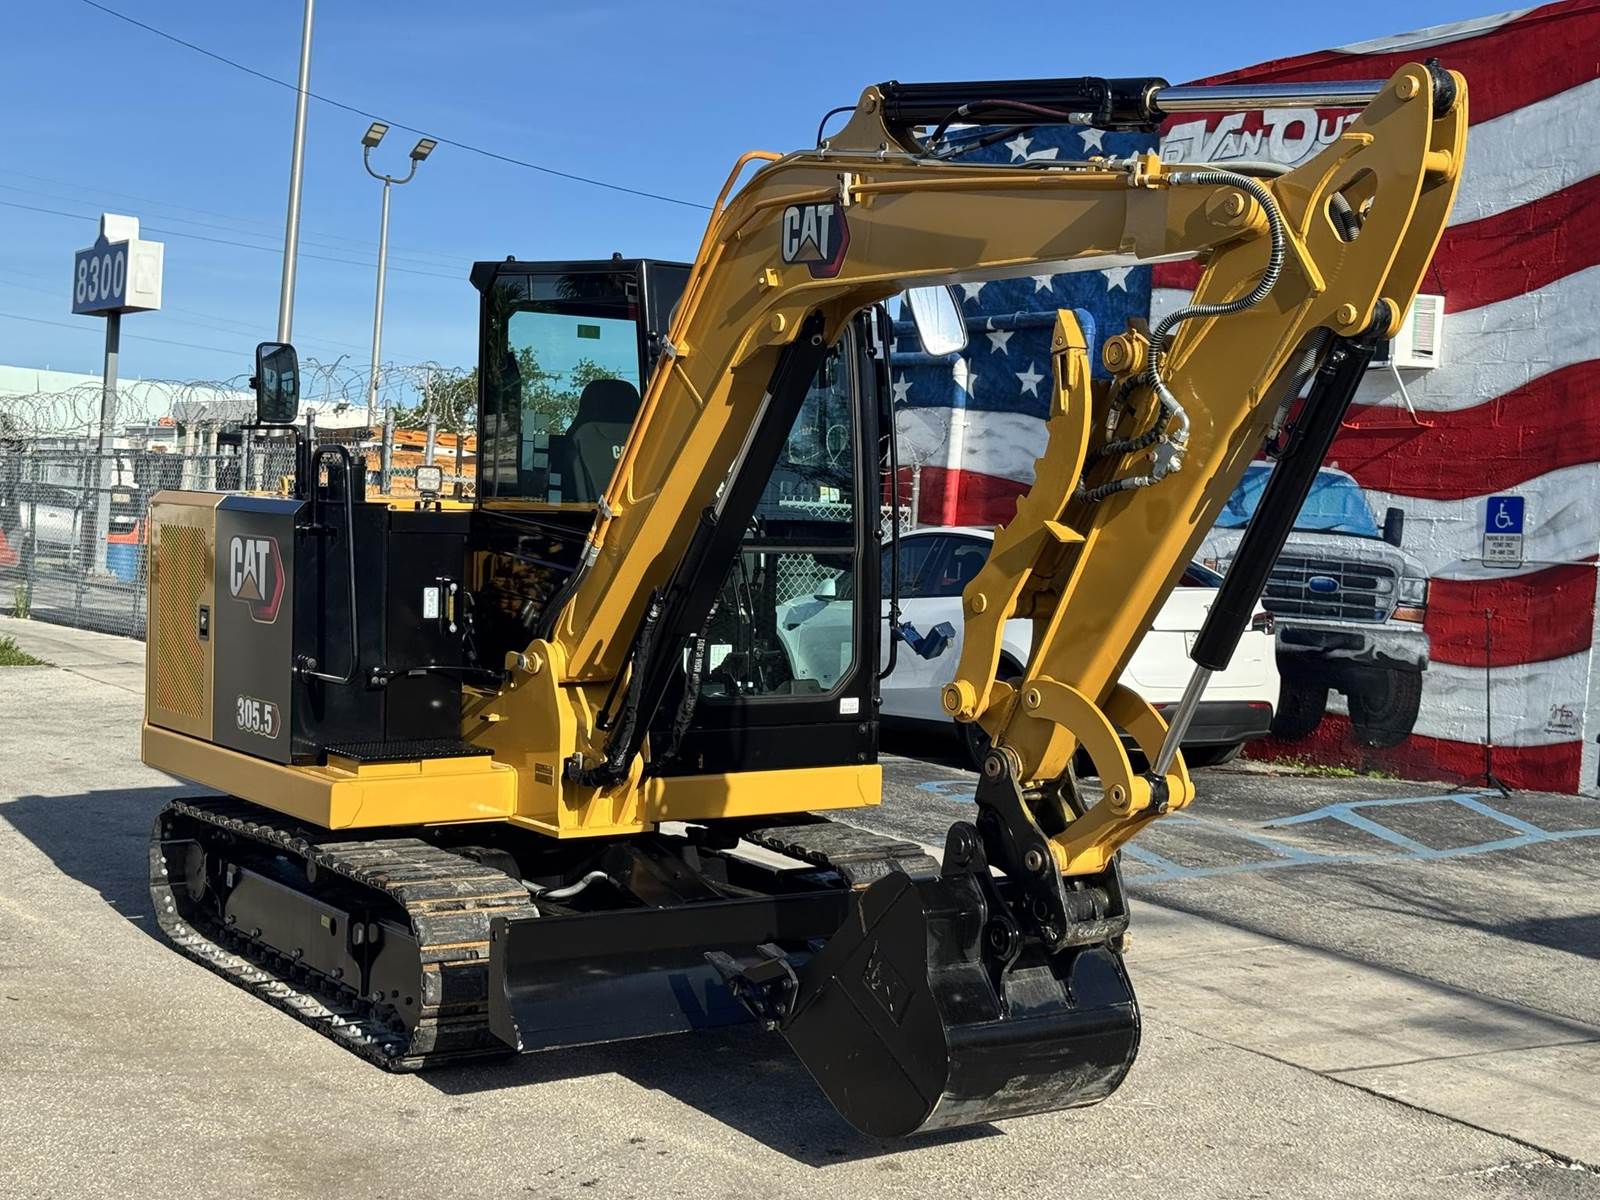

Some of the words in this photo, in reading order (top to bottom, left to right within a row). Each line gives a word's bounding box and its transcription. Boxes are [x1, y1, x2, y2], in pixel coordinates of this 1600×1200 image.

[783, 204, 834, 262] CAT
[76, 250, 125, 304] 8300
[230, 536, 270, 601] CAT
[237, 697, 272, 734] 305.5
